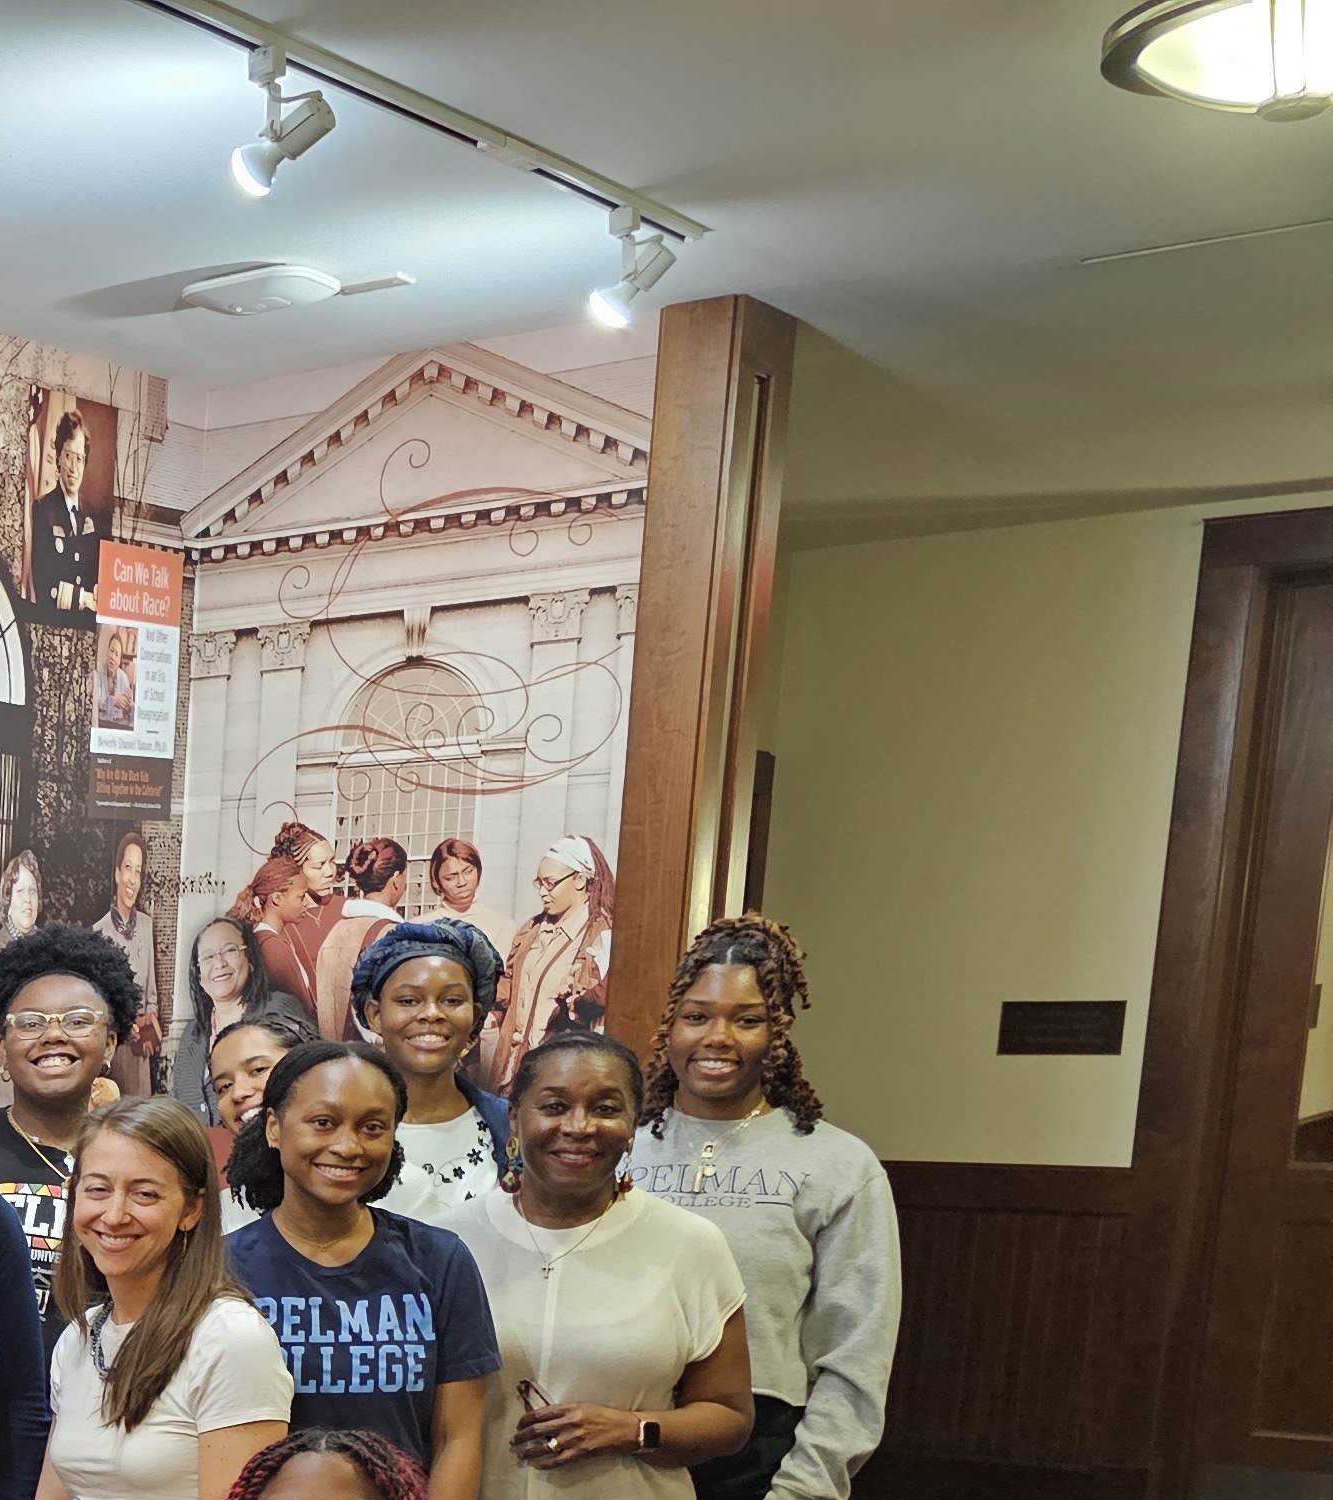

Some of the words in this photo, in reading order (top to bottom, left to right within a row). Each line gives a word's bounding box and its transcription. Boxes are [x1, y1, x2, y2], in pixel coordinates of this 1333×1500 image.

[113, 557, 133, 584] Can
[135, 561, 149, 587] We
[151, 563, 170, 590] Talk
[109, 587, 140, 614] about
[142, 591, 171, 618] Race?
[630, 1163, 811, 1196] PELMAN
[660, 1195, 752, 1209] OLLEGE
[31, 1248, 63, 1264] UNIVE
[253, 1292, 437, 1344] PELMAN
[280, 1344, 427, 1394] LLEGE
